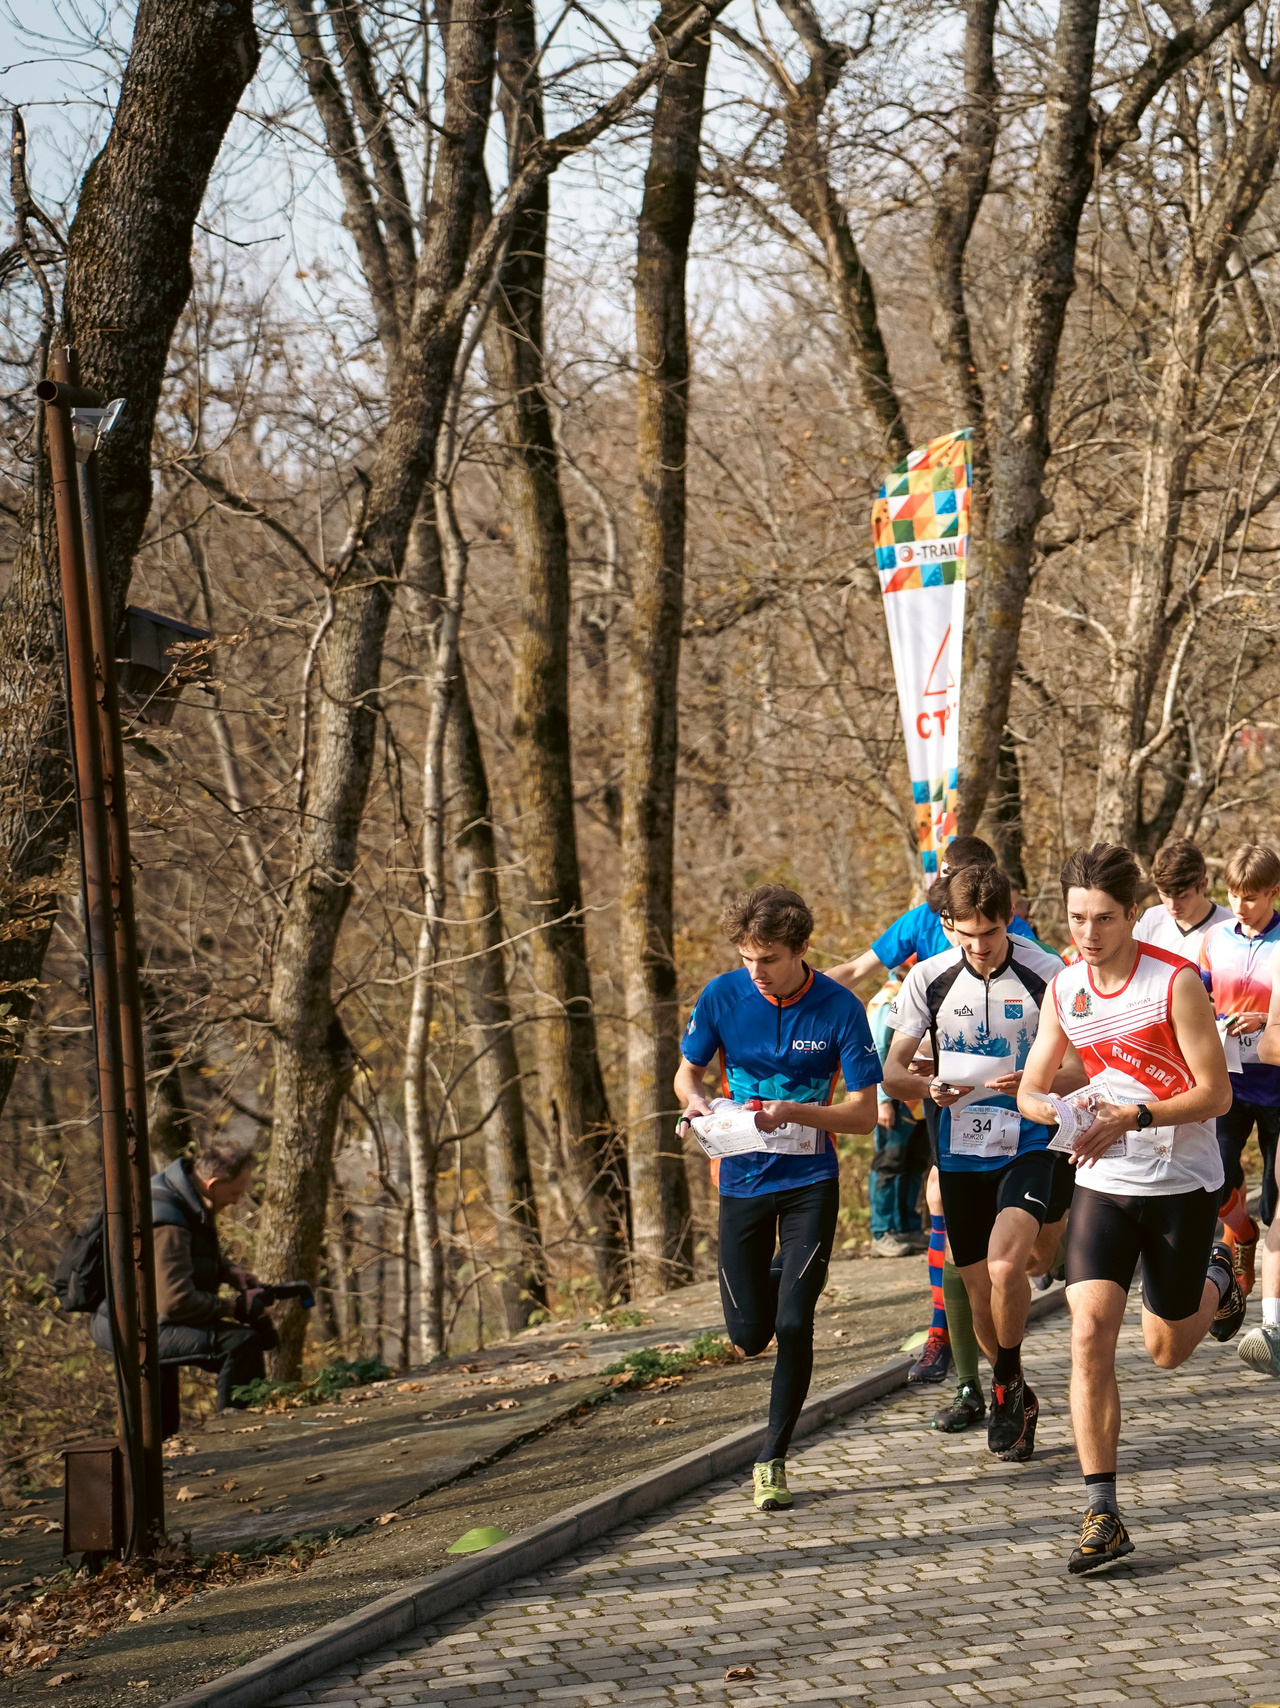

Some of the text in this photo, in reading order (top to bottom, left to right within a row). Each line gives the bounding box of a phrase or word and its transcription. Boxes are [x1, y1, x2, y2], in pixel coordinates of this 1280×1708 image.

[1111, 1044, 1177, 1087] Run and
[972, 1119, 992, 1134] 34
[962, 1132, 984, 1141] МЖ20
